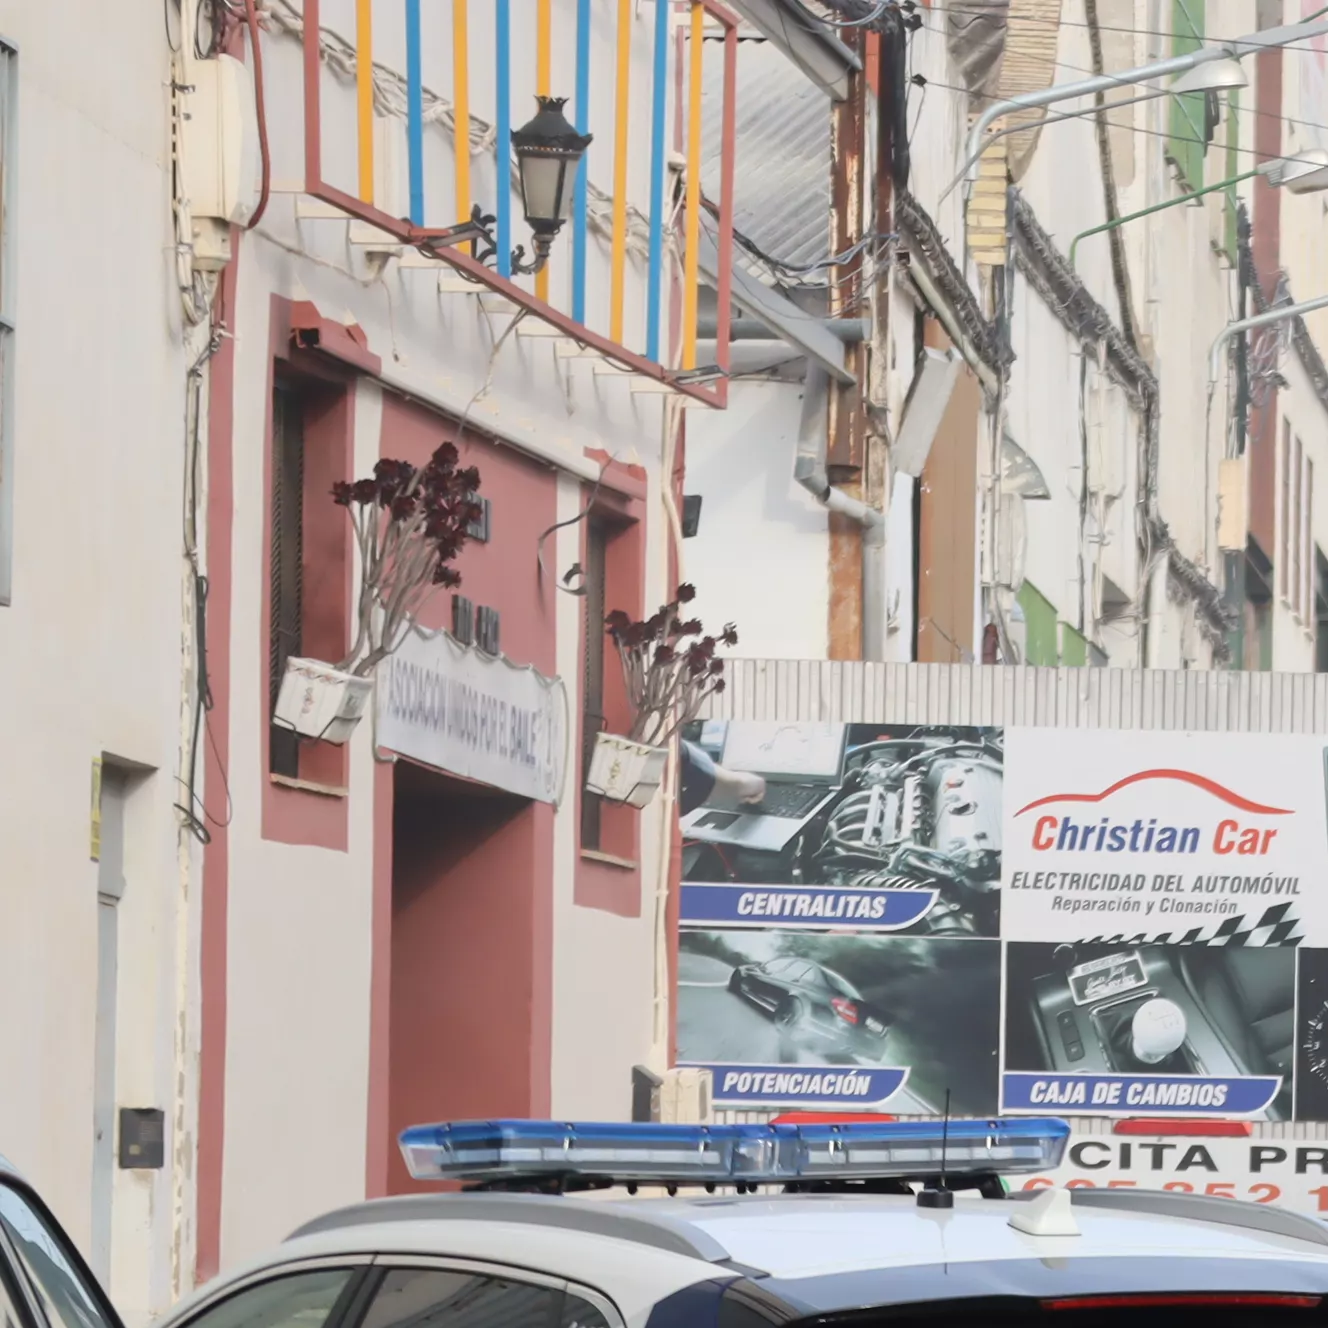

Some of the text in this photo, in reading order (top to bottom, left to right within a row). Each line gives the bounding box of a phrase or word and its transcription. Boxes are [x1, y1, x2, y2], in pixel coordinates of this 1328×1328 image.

[1032, 815, 1278, 855] Christian Car
[1010, 871, 1302, 895] ELECTRICIDAD DEL AUTOMÓVIL
[737, 892, 887, 919] CENTRALITAS
[1051, 896, 1238, 915] Reparación y Clonación
[723, 1070, 872, 1097] POTENCIACIÓN
[1030, 1081, 1228, 1106] CAJA DE CAMBIOS
[1069, 1141, 1218, 1172] CITA
